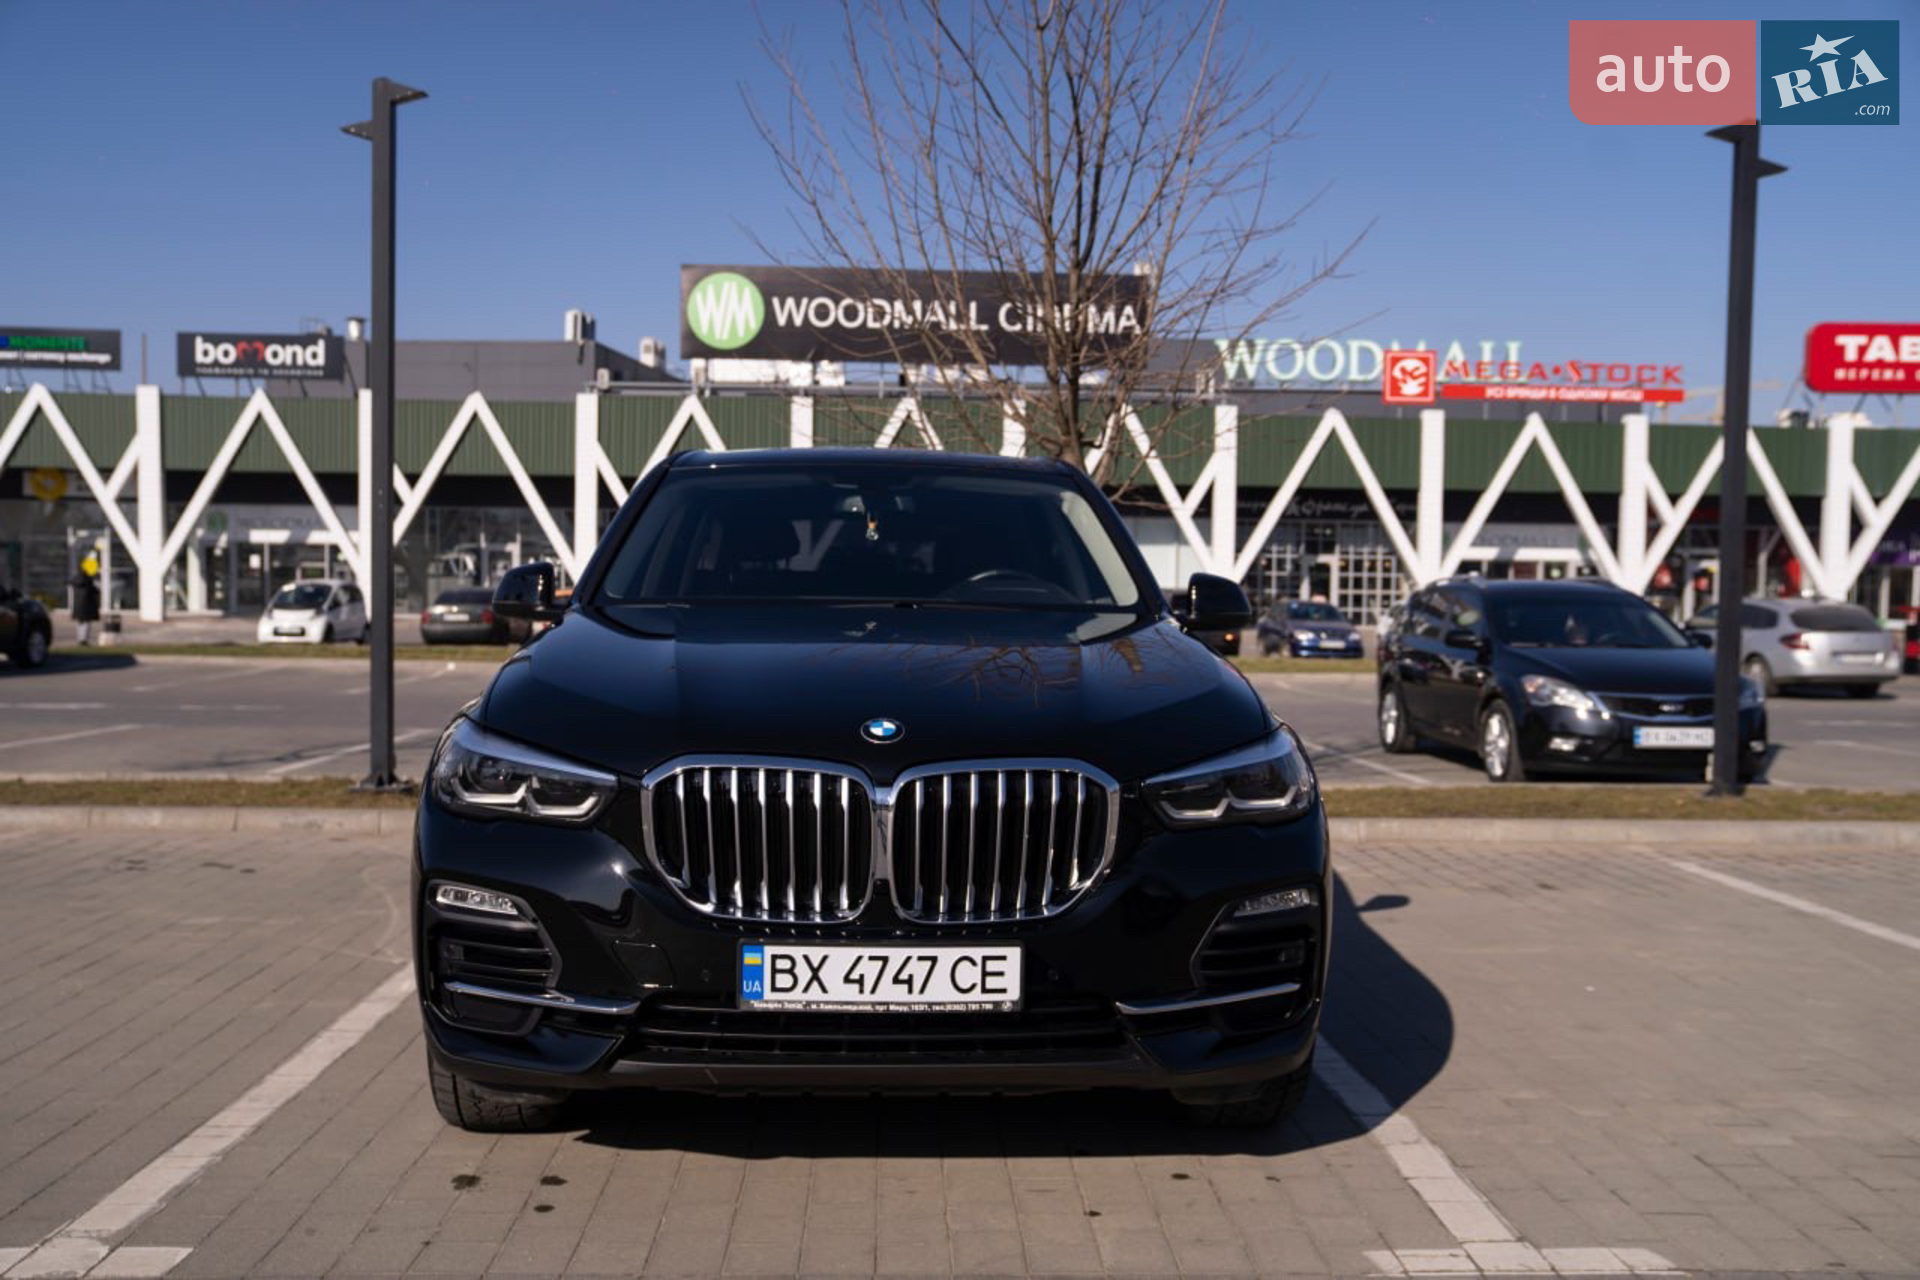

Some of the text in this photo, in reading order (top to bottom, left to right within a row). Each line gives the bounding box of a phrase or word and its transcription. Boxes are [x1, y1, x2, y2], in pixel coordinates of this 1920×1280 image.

[771, 296, 989, 332] WOODMALL
[194, 335, 326, 367] bomond
[1214, 338, 1530, 383] WOODALL
[743, 980, 762, 993] UA
[770, 953, 1008, 995] BX 4747 CE
